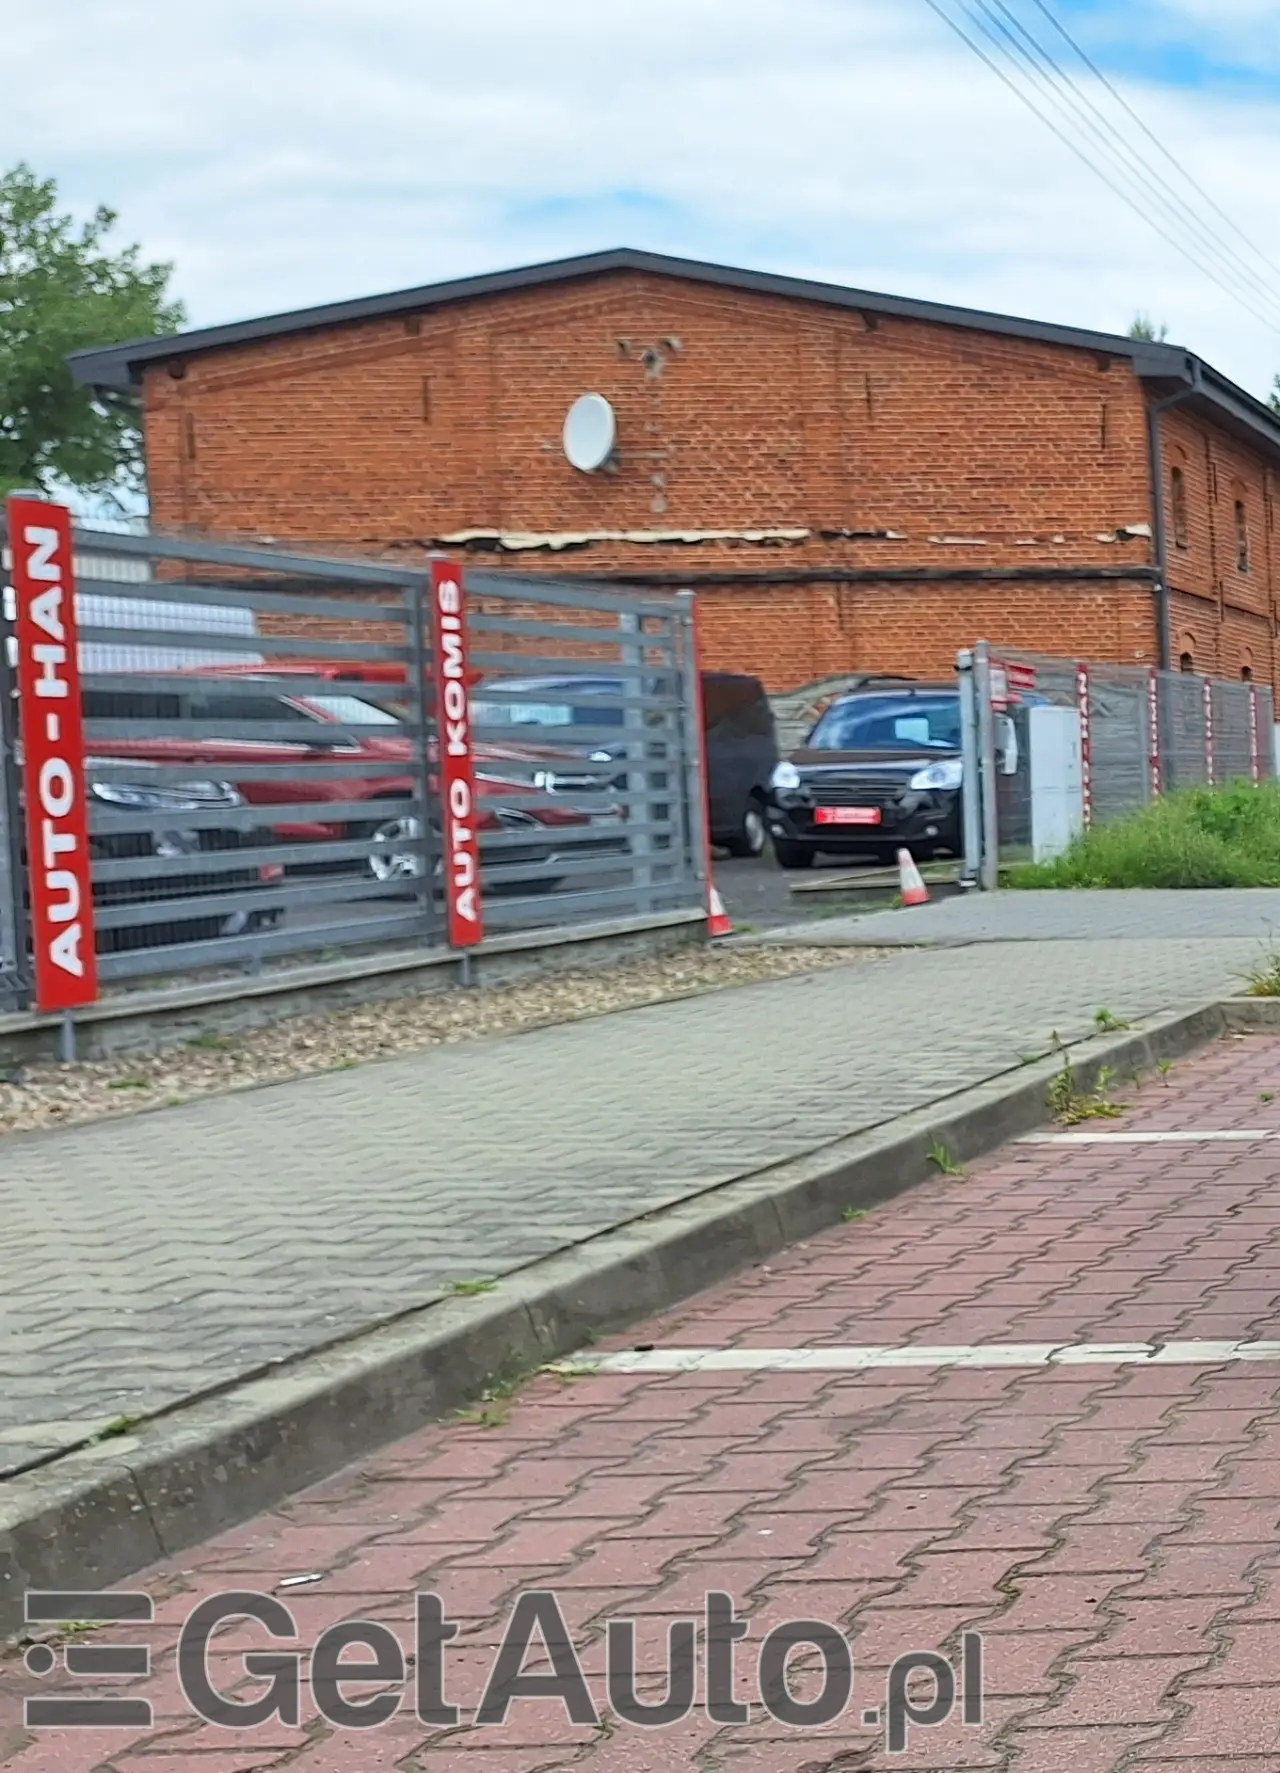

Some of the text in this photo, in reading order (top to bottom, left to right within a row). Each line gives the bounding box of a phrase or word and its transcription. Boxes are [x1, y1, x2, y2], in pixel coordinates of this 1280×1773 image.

[25, 526, 69, 698] HAN
[438, 579, 478, 921] AUTO KOMIS
[39, 757, 83, 977] AUTO
